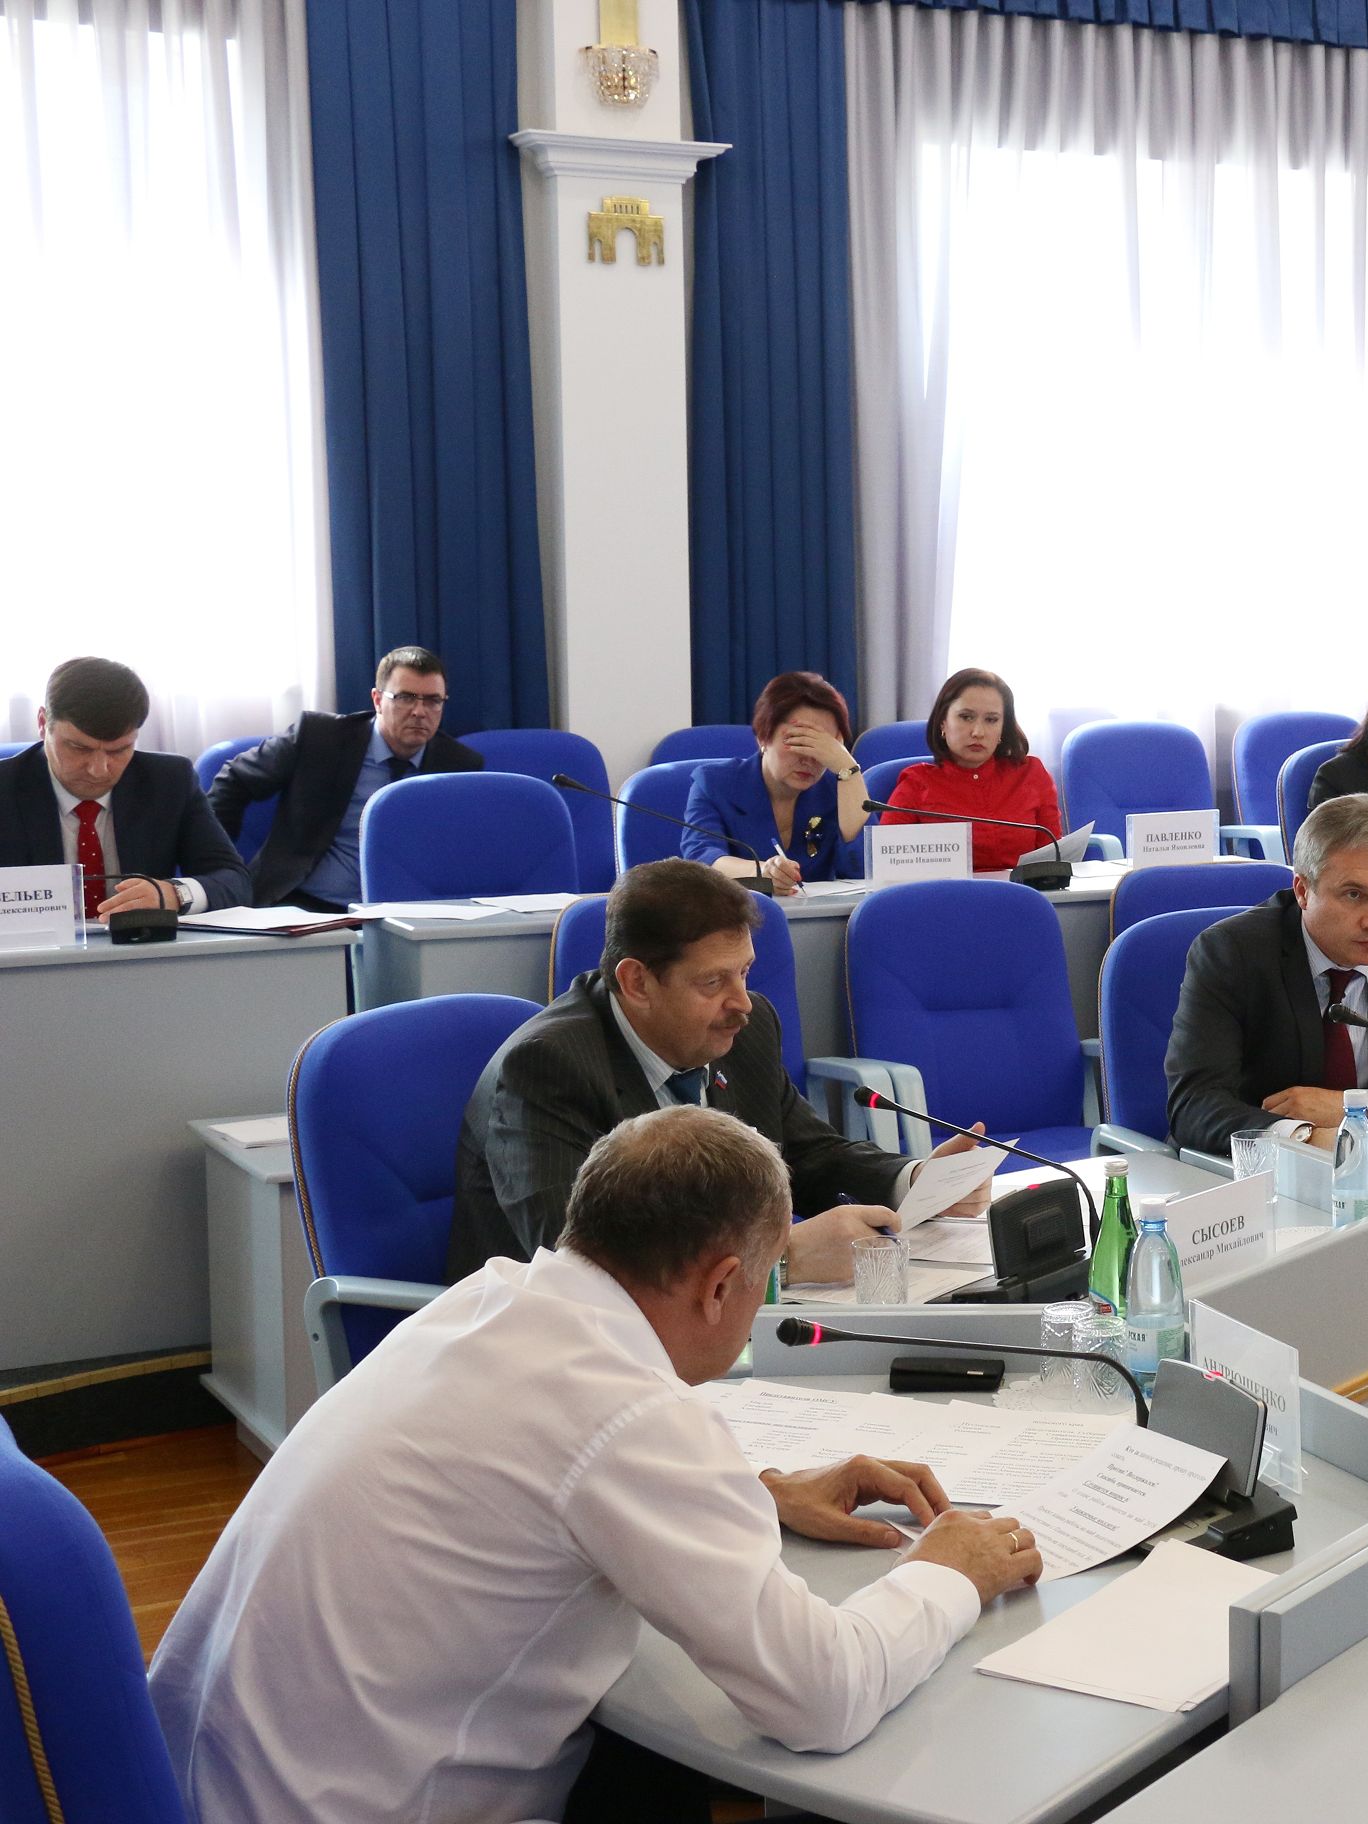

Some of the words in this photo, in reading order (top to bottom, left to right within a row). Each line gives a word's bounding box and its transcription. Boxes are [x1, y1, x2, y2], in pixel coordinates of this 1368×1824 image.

[1146, 831, 1202, 843] ПАВЛЕНКО
[881, 843, 960, 855] ВЕРЕМЕЕНКО
[1143, 845, 1170, 853] Наталья
[0, 889, 53, 902] ЕЛЬЕВ
[0, 905, 67, 915] лександрович
[1191, 1215, 1245, 1245] СЫСОЕВ
[1180, 1249, 1214, 1268] лександр
[1215, 1231, 1264, 1254] Михайлович
